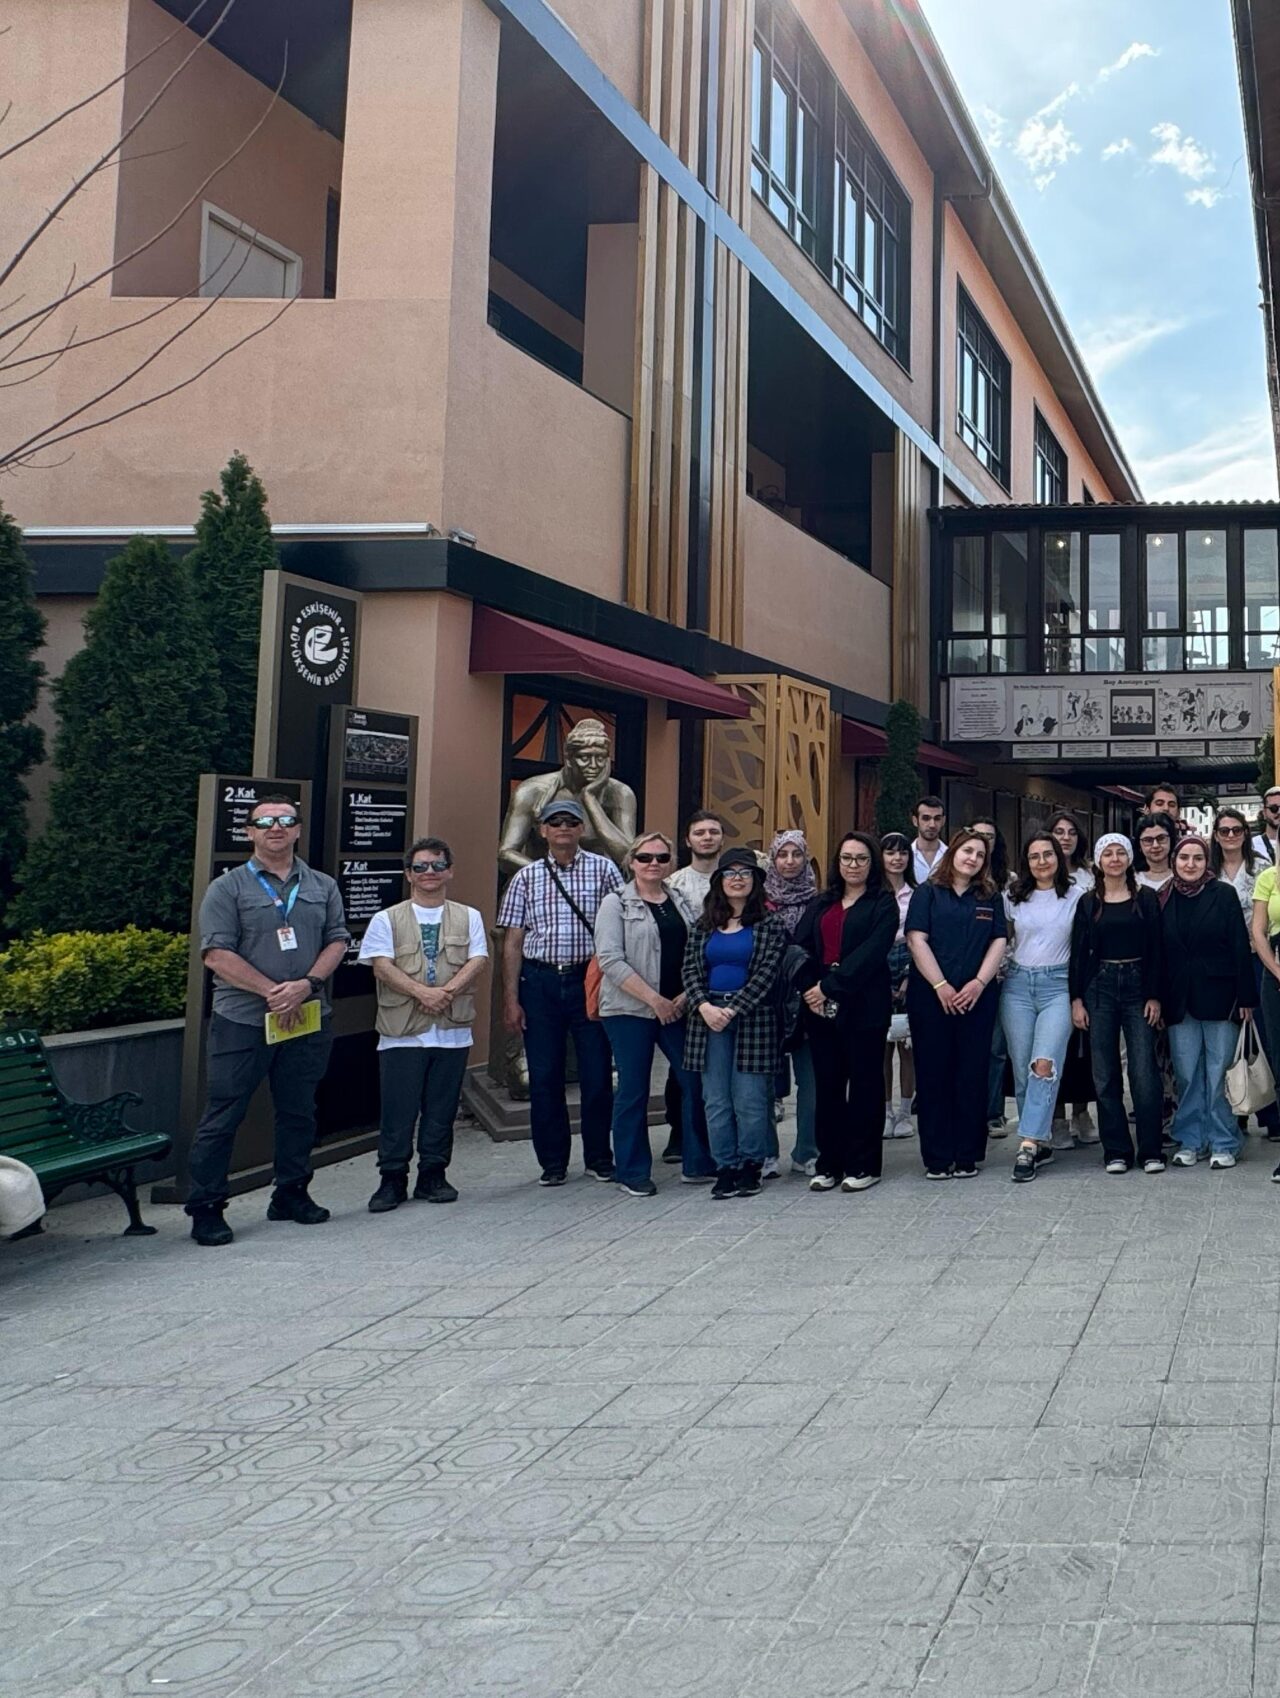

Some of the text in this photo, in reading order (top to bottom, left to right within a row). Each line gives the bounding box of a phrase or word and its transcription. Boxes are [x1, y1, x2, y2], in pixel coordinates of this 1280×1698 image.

[300, 601, 342, 626] ESKİŞEHİR
[224, 786, 256, 802] 2.Kat
[349, 793, 372, 806] 1.Kat
[343, 861, 368, 875] Z.Kat
